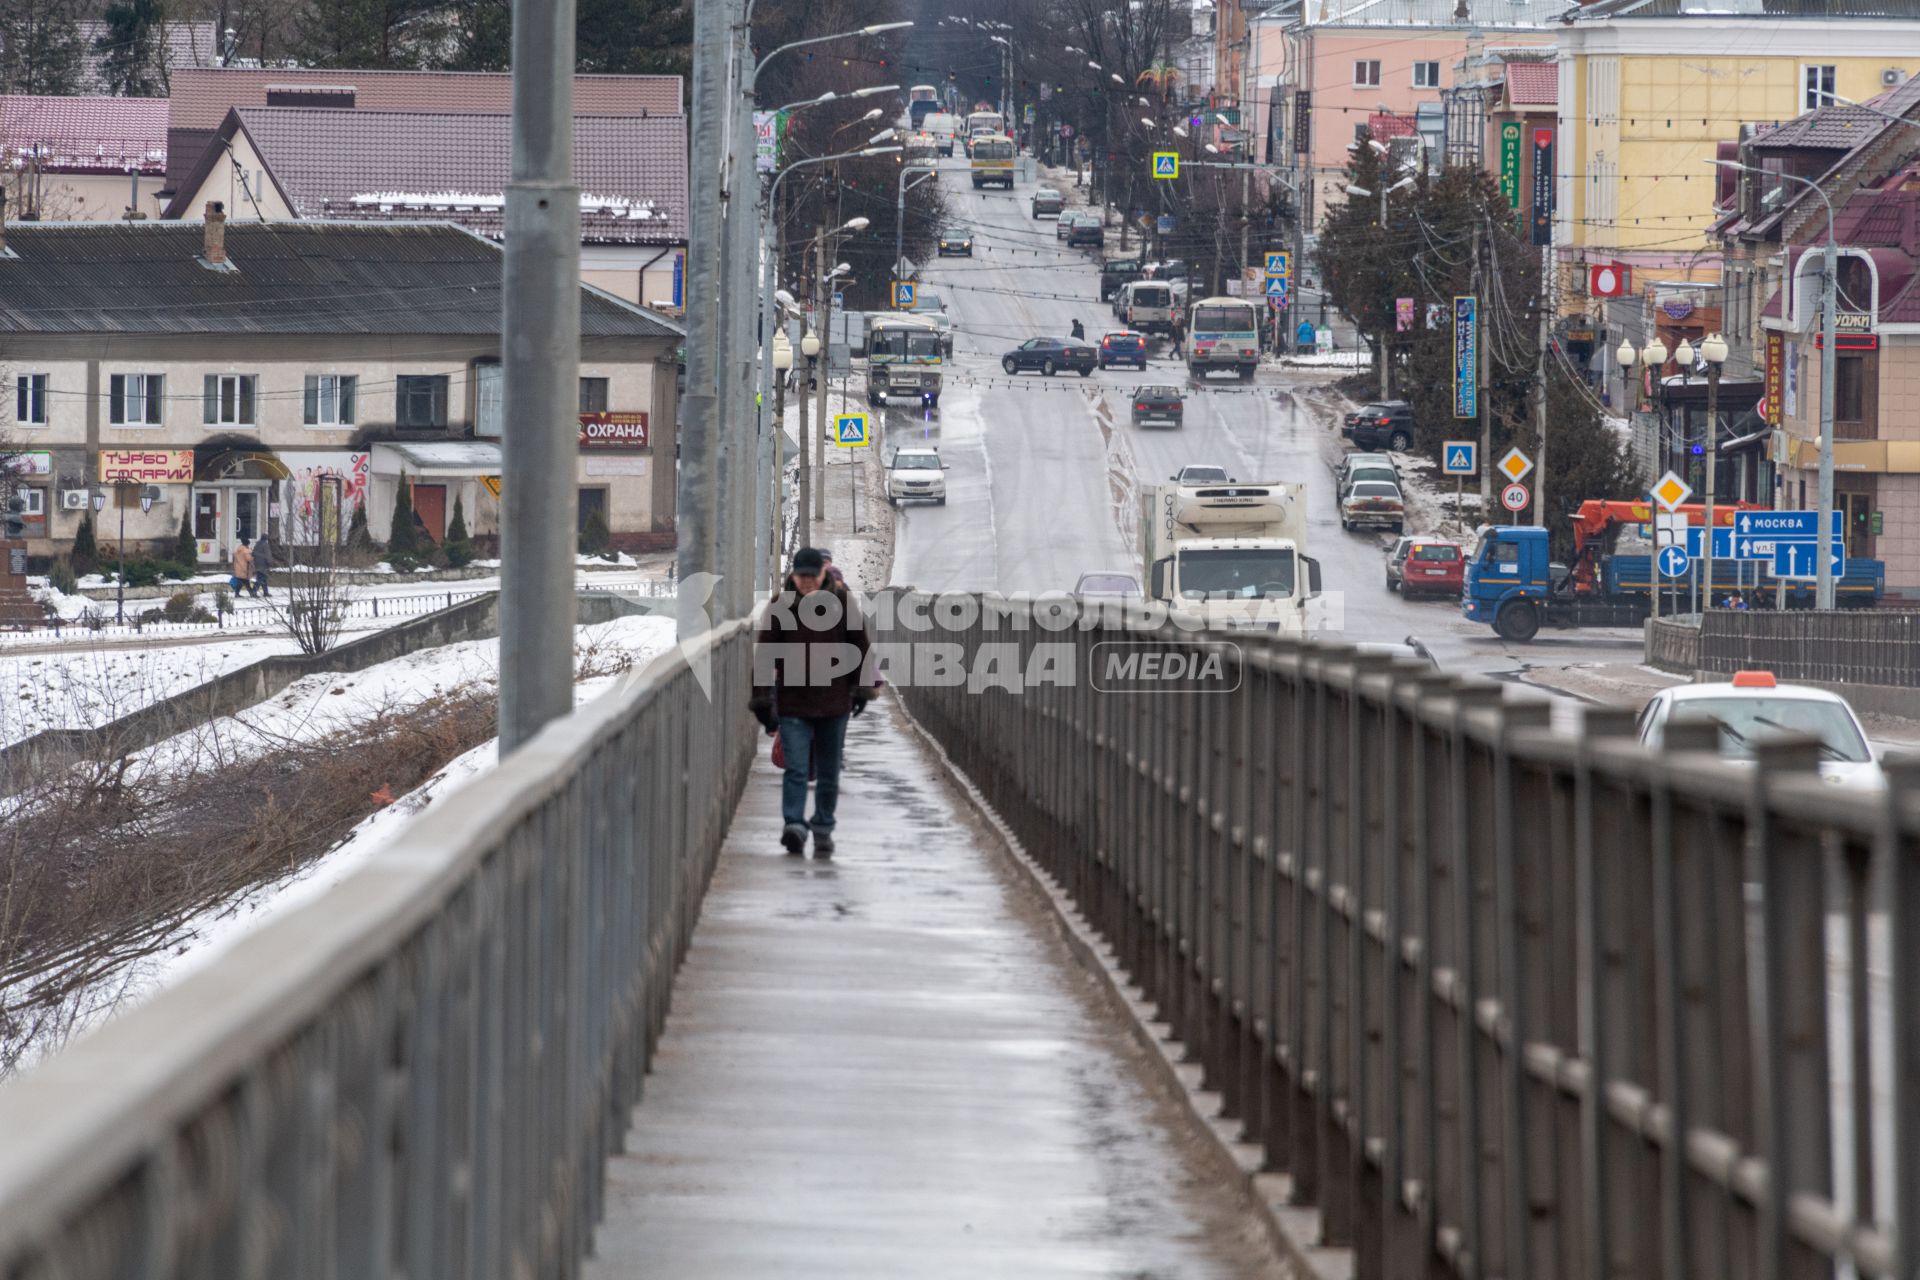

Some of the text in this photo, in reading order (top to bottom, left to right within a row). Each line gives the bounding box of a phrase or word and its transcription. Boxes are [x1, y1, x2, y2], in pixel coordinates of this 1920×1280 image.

[1822, 315, 1870, 327] УДЖИ
[1769, 336, 1780, 423] ЮВЕЛИРНЫЙ
[587, 424, 644, 437] ОХРАНА
[105, 454, 168, 465] ТУРБО
[105, 465, 192, 480] СОЛАРИЙ
[1507, 492, 1523, 502] 40
[1755, 519, 1803, 528] МОСКВА
